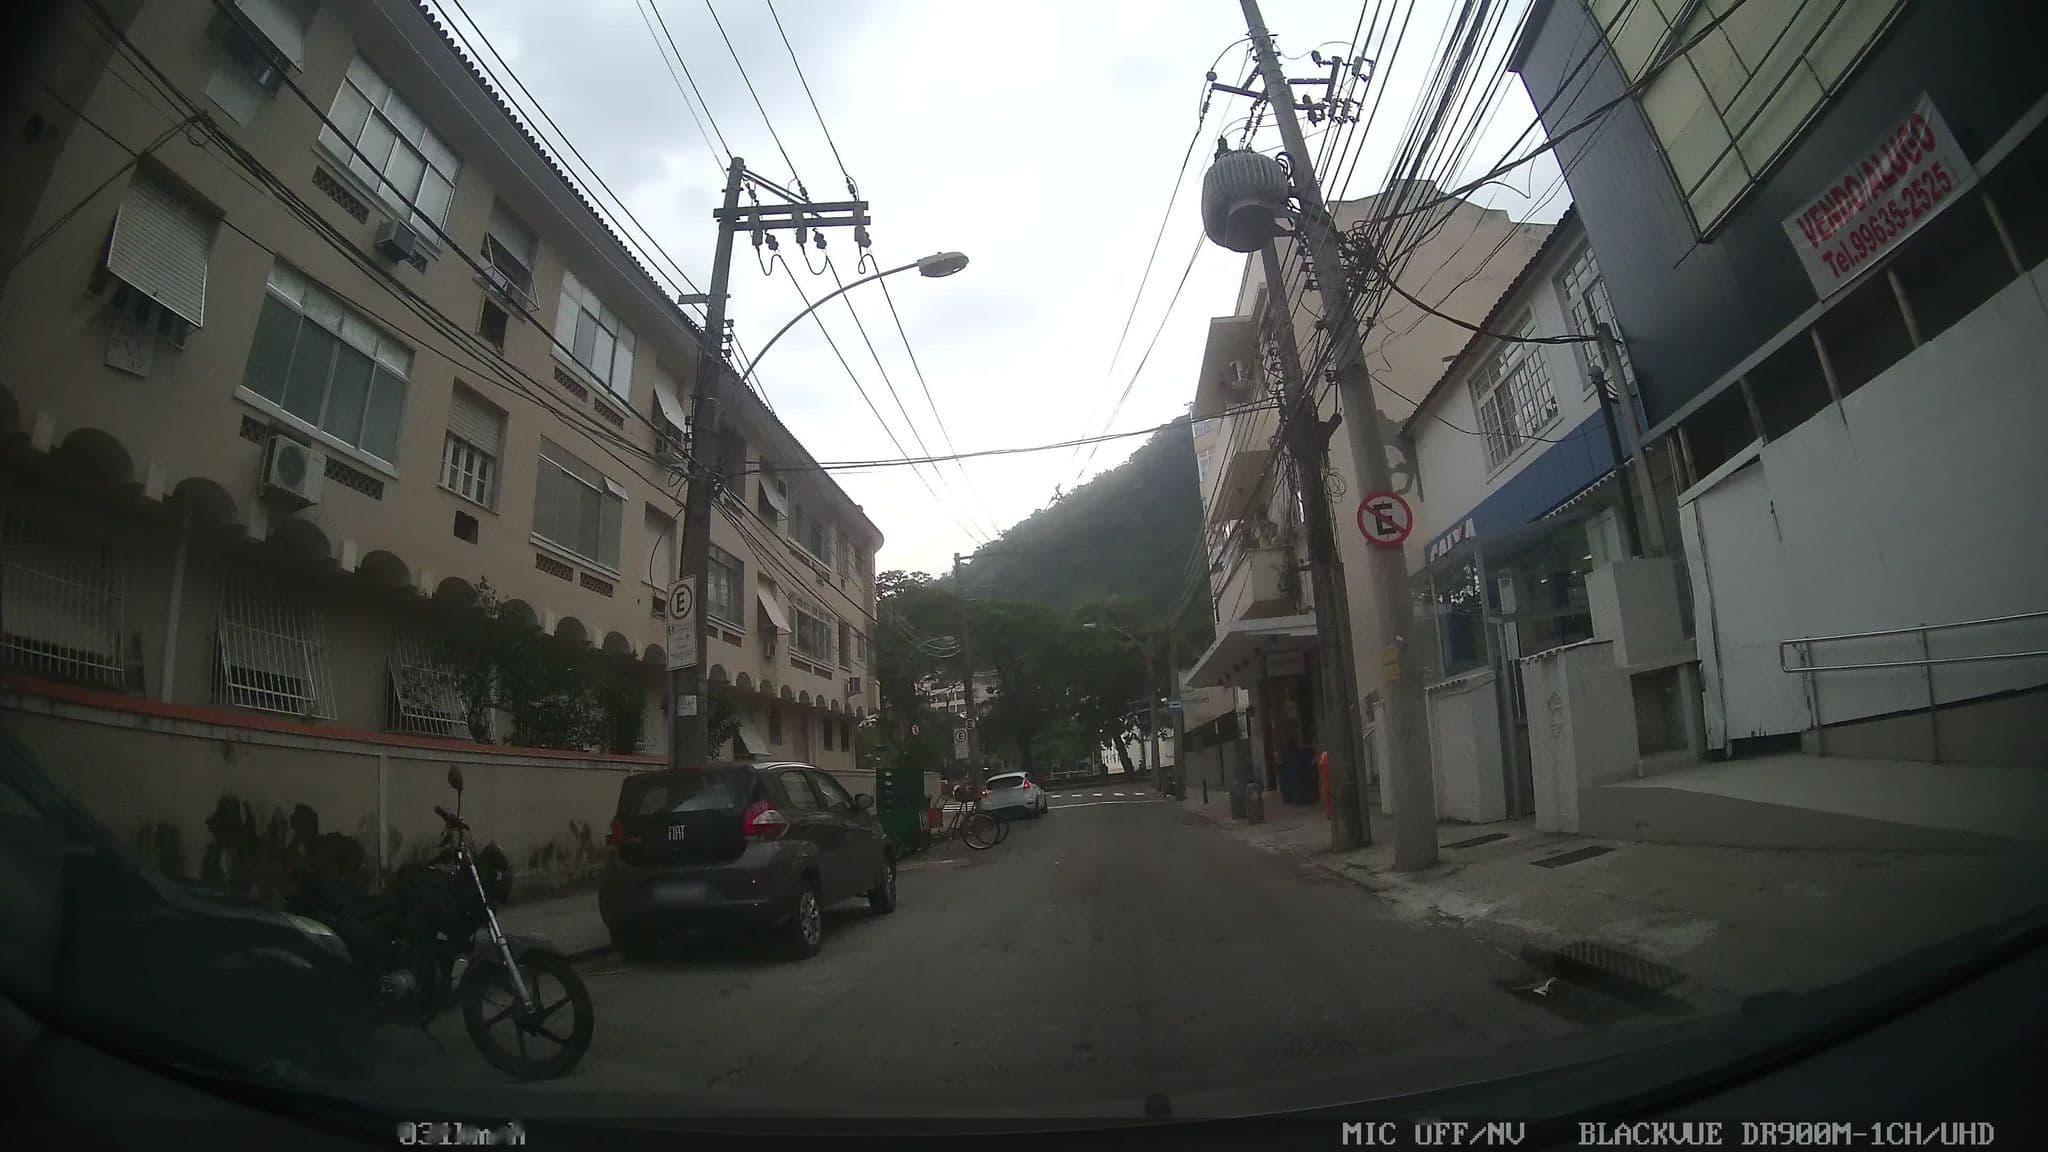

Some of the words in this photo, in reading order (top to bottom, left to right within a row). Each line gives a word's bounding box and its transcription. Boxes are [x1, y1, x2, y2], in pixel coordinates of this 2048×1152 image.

[1796, 112, 1936, 248] VENDO/ALUGO
[1373, 503, 1396, 535] E
[676, 591, 685, 613] E
[668, 824, 686, 841] FIAT
